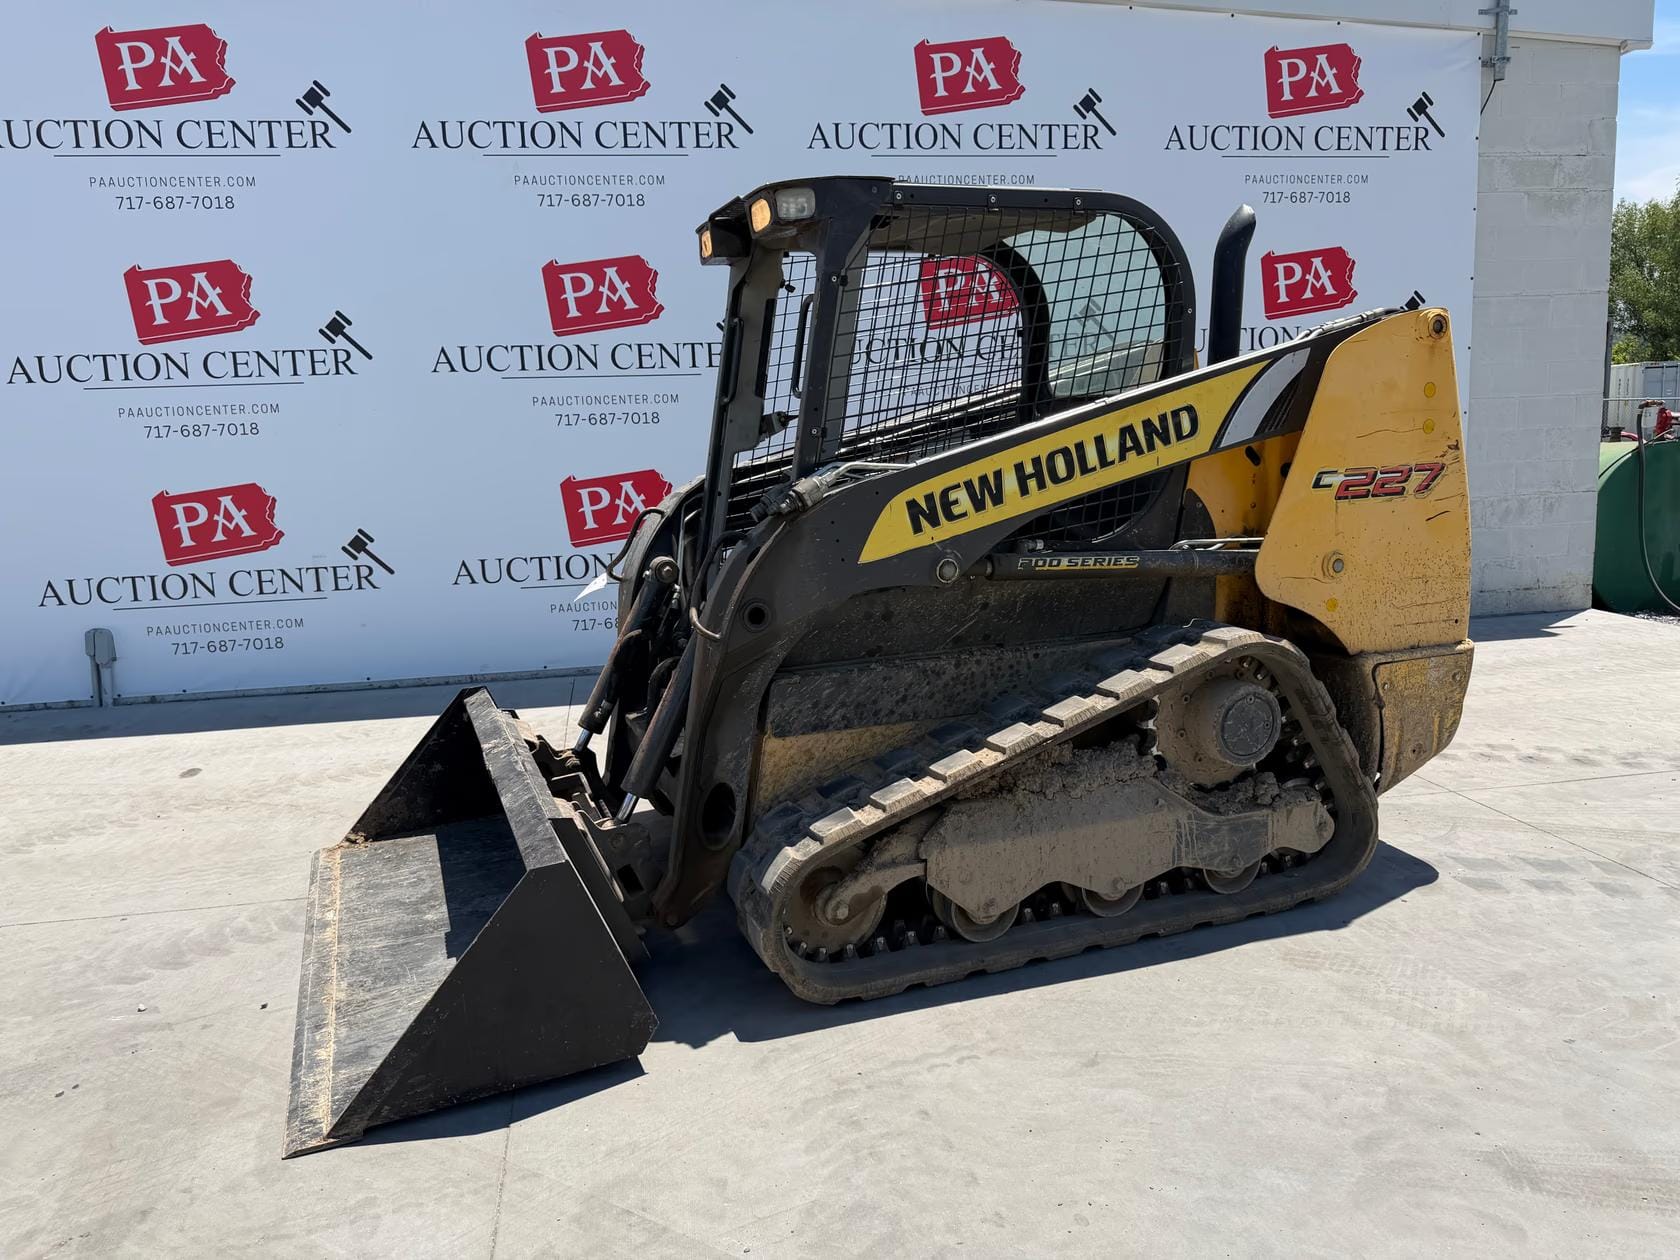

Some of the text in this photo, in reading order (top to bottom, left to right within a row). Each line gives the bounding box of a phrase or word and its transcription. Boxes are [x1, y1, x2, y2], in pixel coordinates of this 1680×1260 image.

[115, 36, 206, 90] PA
[543, 42, 624, 93] PA
[930, 48, 1002, 96] PA
[1278, 54, 1342, 100] PA
[0, 119, 336, 149] UCTION CENTER
[411, 120, 739, 149] AUCTION CENTER
[807, 122, 1103, 150] AUCTION CENTER
[1164, 125, 1432, 151] AUCTION CENTER
[90, 176, 255, 187] PAAUCTIONCENTER.COM
[515, 175, 664, 185] PAAUCTIONCENTER.COM
[1245, 175, 1368, 184] PAAUCTIONCENTER.COM
[115, 196, 234, 210] 717-687-7018
[537, 194, 645, 207] 717-687-7018
[1263, 192, 1350, 203] 717-687-7018
[559, 267, 638, 317] PA
[1275, 257, 1336, 302] PA
[143, 272, 232, 325] PA
[6, 349, 358, 384] AUCTION CENTER
[432, 342, 722, 373] AUCTION CENTE
[119, 403, 279, 418] PAAUCTIONCENTER.COM
[533, 394, 678, 406] PAAUCTIONCENTER.COM
[144, 422, 259, 438] 717-687-7018
[555, 412, 660, 426] 717-687-7018
[905, 403, 1200, 537] NEW HOLLAND
[576, 480, 647, 530] PA
[170, 495, 256, 547] PA
[452, 553, 616, 585] AUCTION
[1066, 556, 1139, 570] SERIES
[39, 565, 381, 607] AUCTION CENTER
[147, 618, 304, 636] PAAUCTIONCENTER.COM
[172, 637, 284, 655] 717-687-7018
